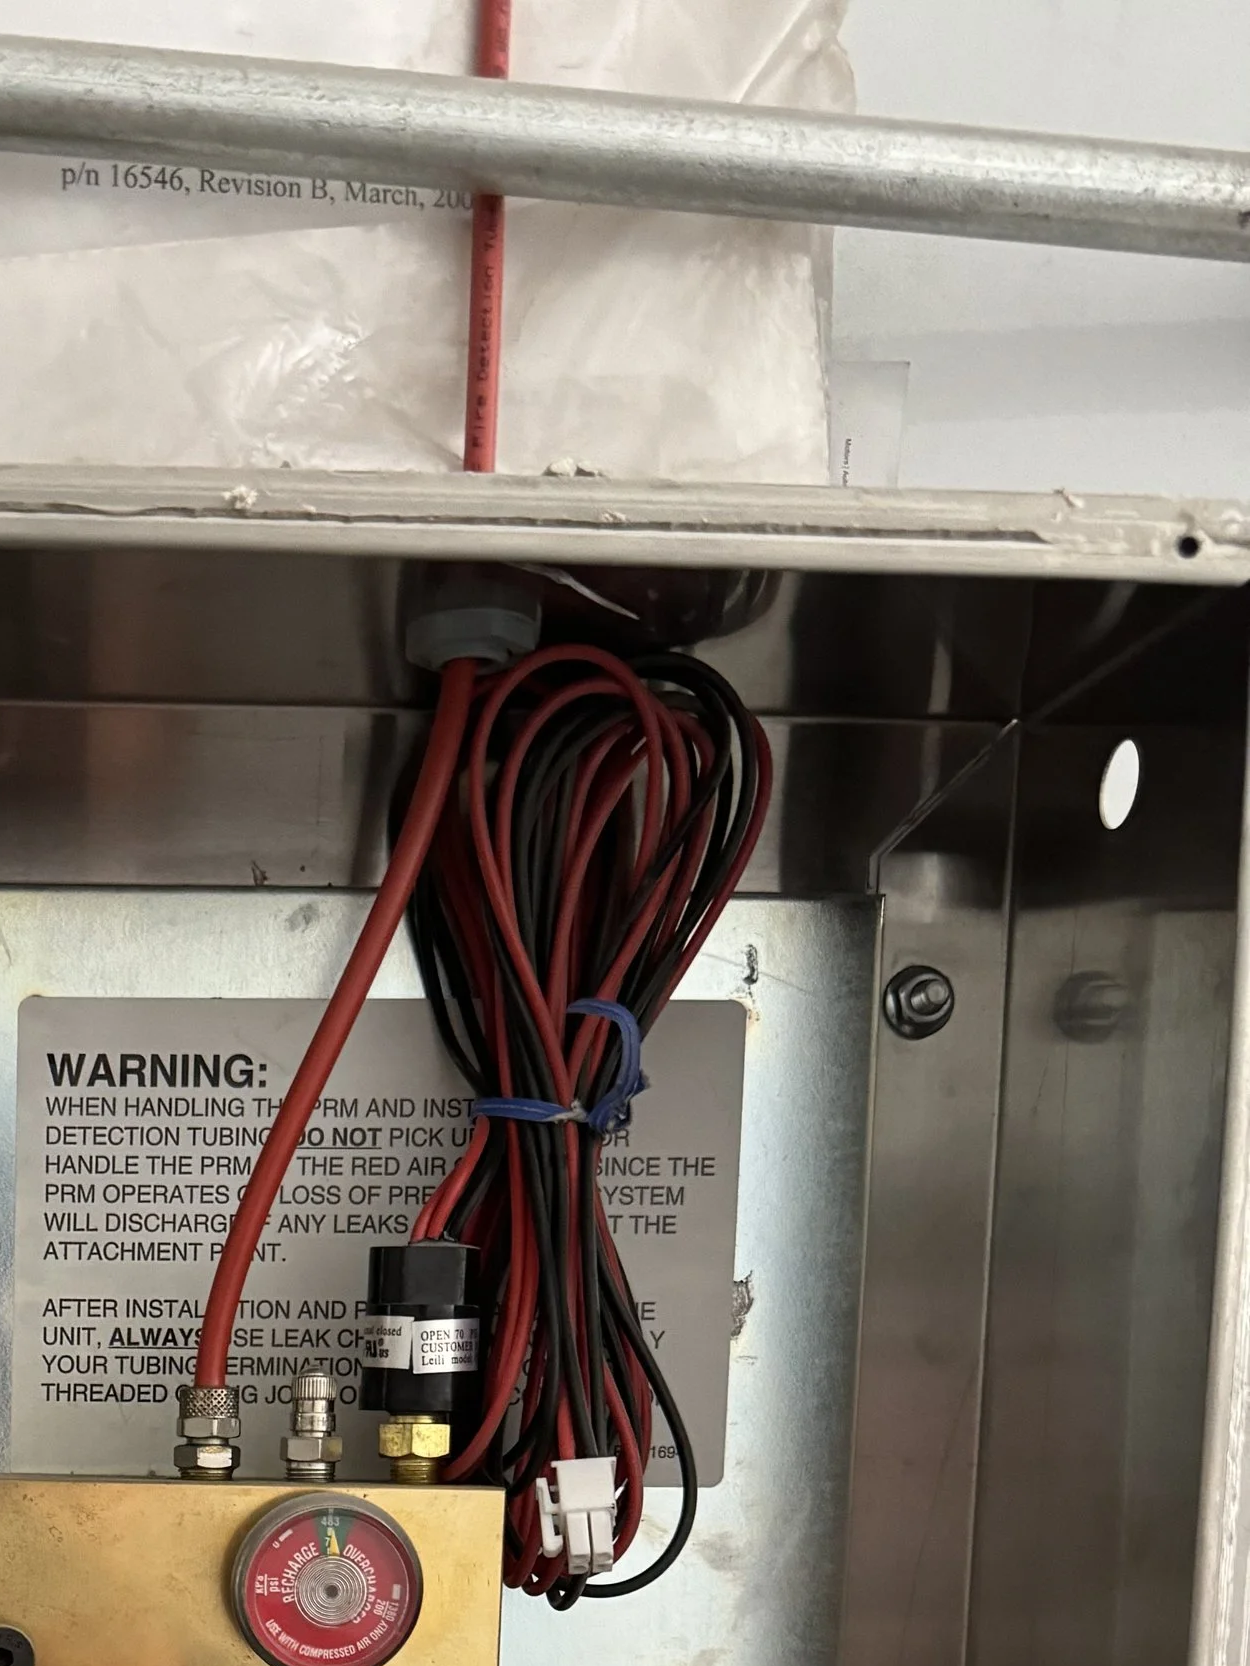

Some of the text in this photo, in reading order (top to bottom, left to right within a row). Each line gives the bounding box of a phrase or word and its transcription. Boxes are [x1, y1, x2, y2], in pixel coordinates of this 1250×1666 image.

[62, 162, 474, 211] p/n 16546, Revision B, March, 200
[46, 1053, 269, 1088] WARNING:
[46, 1097, 117, 1118] WHEN
[125, 1097, 245, 1118] HANDLING
[251, 1097, 283, 1118] TH
[365, 1097, 415, 1118] AND
[46, 1126, 180, 1147] DETECTION
[332, 1126, 382, 1147] NOT
[389, 1126, 444, 1147] PICK
[45, 1155, 139, 1176] HANDLE
[145, 1155, 193, 1176] THE
[201, 1155, 251, 1176] PRM
[296, 1155, 343, 1176] THE
[352, 1155, 400, 1176] RED
[407, 1155, 446, 1176] AIR
[668, 1155, 715, 1176] THE
[45, 1184, 95, 1205] PRM
[103, 1184, 230, 1205] OPERATES
[279, 1184, 341, 1205] LOSS
[348, 1184, 382, 1205] OF
[600, 1184, 685, 1205] YSTEM
[44, 1212, 98, 1233] WILL
[278, 1212, 326, 1233] ANY
[333, 1212, 408, 1233] LEAKS
[629, 1212, 677, 1233] THE
[43, 1241, 286, 1262] ATTACHMENT PNT.
[42, 1299, 118, 1319] AFTER
[126, 1299, 291, 1319] INSTALTION
[297, 1299, 346, 1319] AND
[43, 1327, 101, 1349] UNIT,
[228, 1328, 264, 1347] SE
[272, 1328, 329, 1347] LEAK
[420, 1330, 450, 1341] OPEN
[455, 1329, 464, 1340] 70
[42, 1355, 364, 1376] YOUR TUBING ERMINATION
[41, 1382, 168, 1402] THREADED
[281, 1541, 319, 1604] RECHARGE
[268, 1577, 281, 1593] psi
[373, 1599, 386, 1616] 200
[265, 1619, 389, 1660] USE WITH COMPRESSED AIR ONLY
